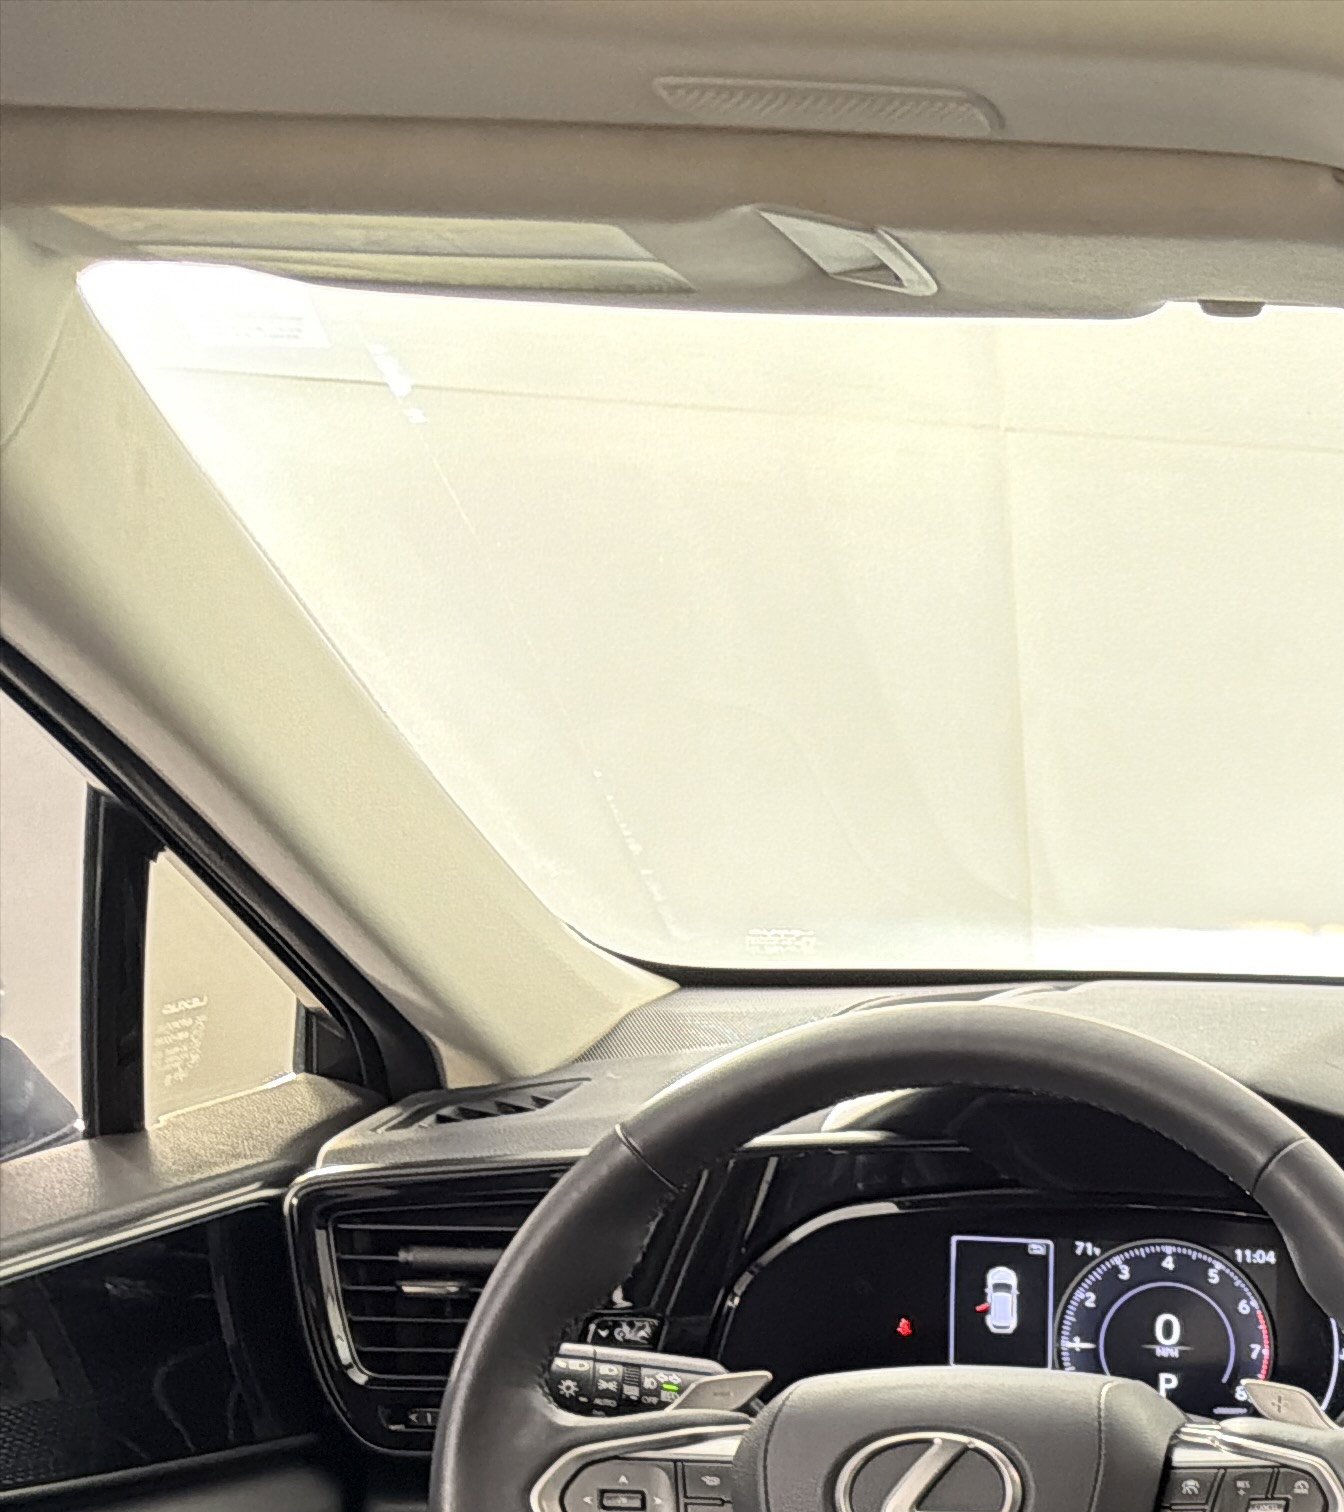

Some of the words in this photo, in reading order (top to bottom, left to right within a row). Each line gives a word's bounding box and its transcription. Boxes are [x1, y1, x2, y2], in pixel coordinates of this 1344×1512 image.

[1161, 1256, 1175, 1271] 4
[1234, 1249, 1277, 1265] 11:04
[1117, 1265, 1131, 1281] 3
[1207, 1269, 1221, 1285] 5
[1083, 1292, 1097, 1308] 2
[1237, 1299, 1251, 1315] 6
[1154, 1313, 1181, 1346] 0
[1250, 1343, 1262, 1360] 7
[1158, 1372, 1179, 1399] P
[1234, 1385, 1248, 1401] 8
